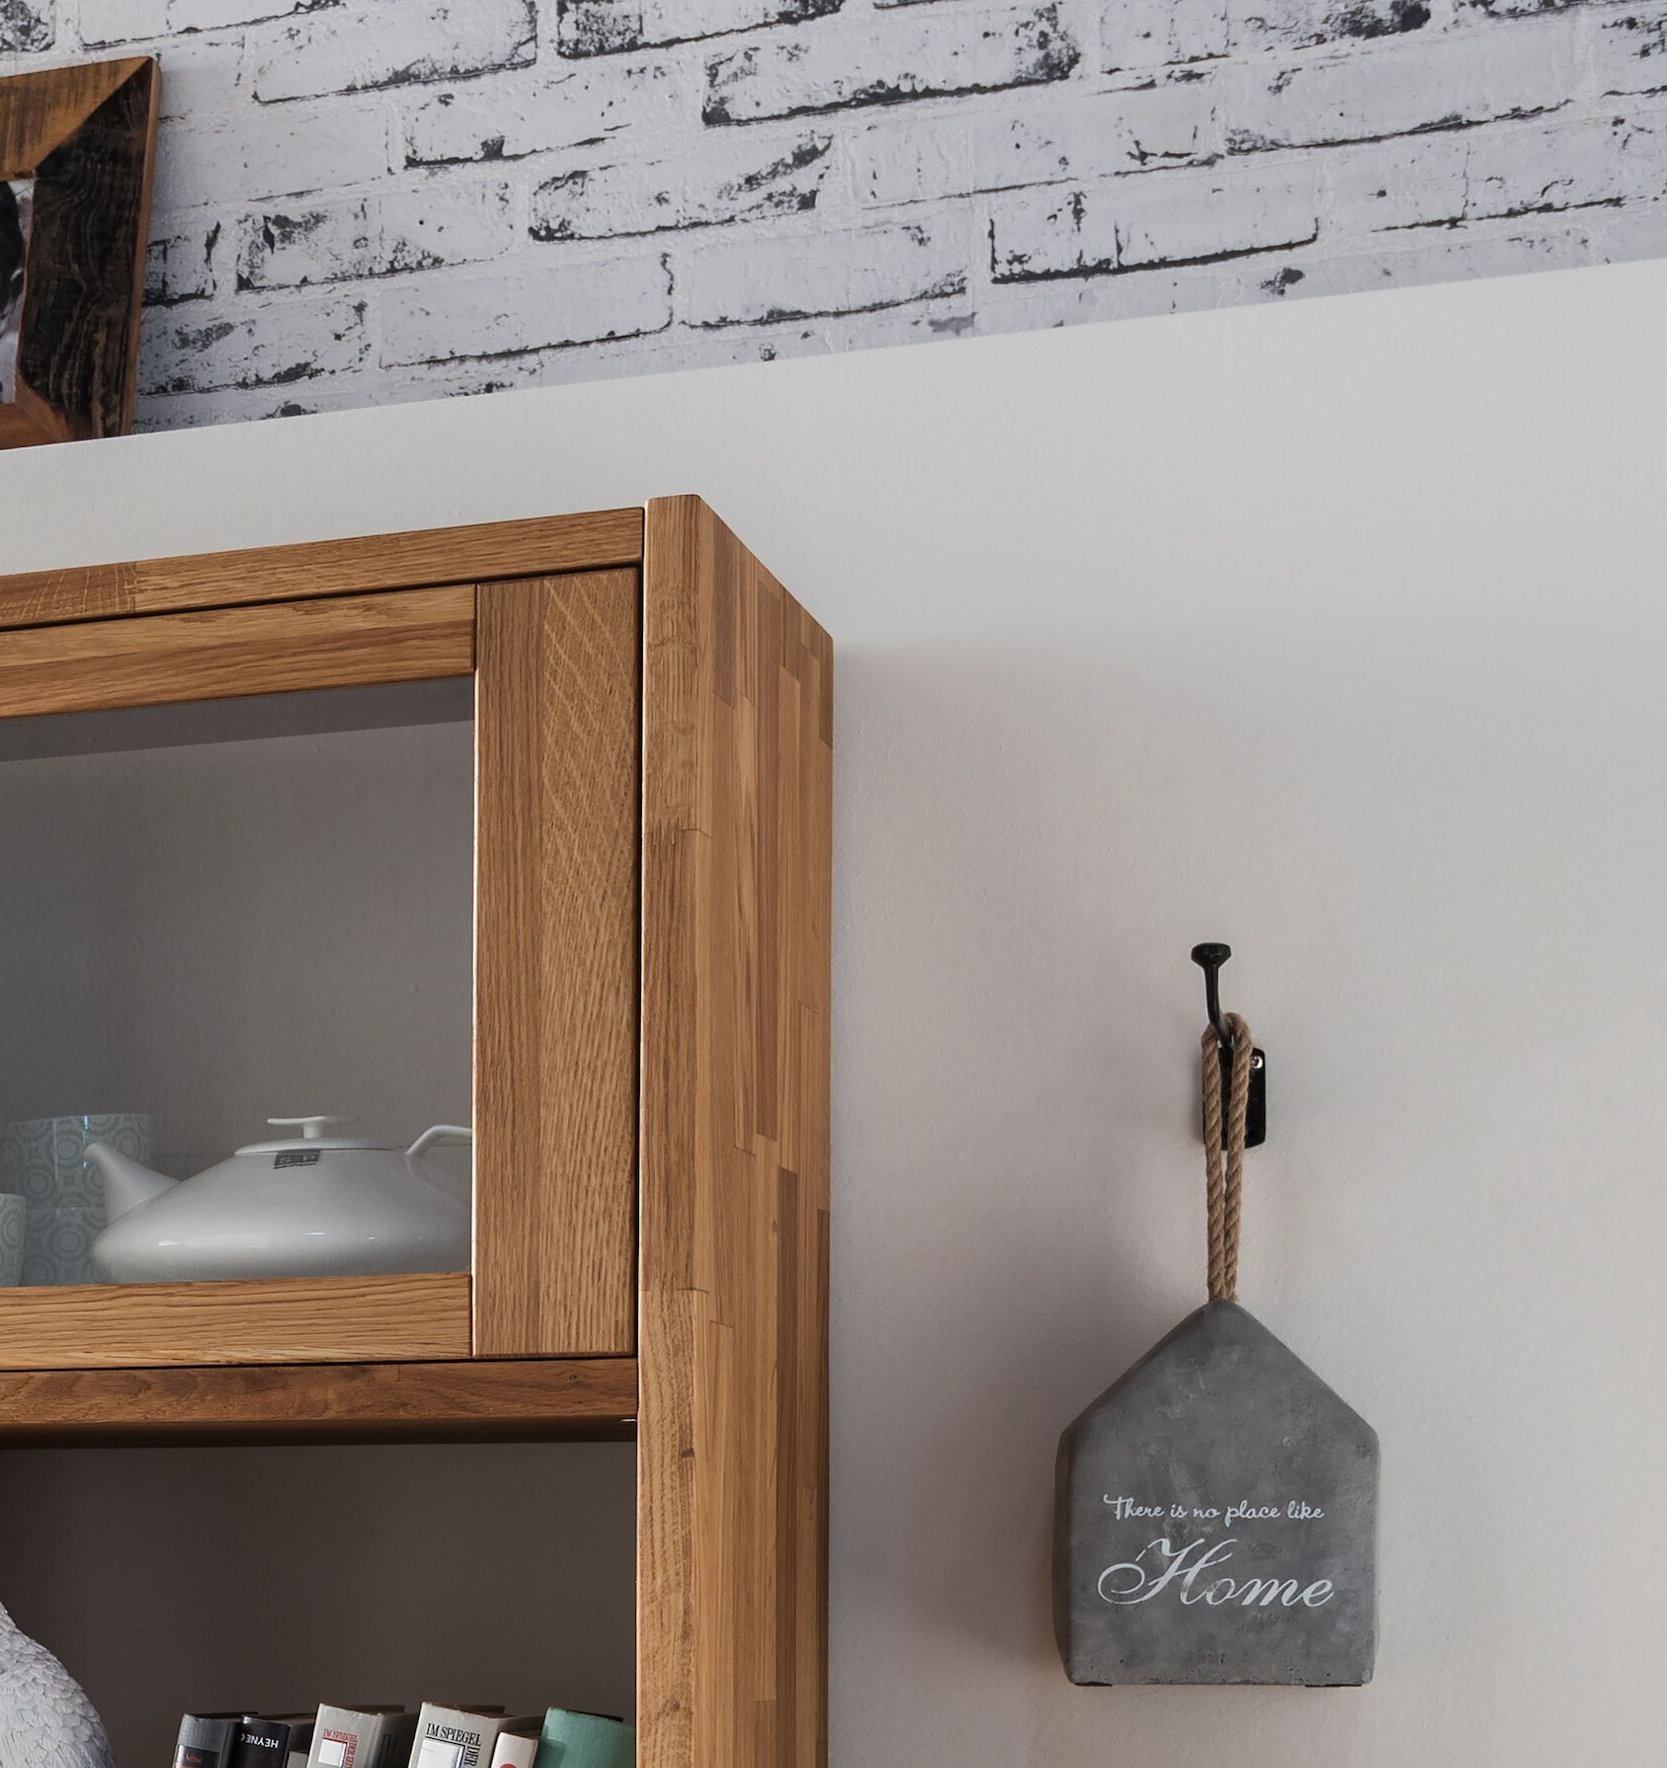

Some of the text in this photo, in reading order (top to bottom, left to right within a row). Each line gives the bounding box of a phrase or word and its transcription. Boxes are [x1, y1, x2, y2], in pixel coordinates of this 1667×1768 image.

[1103, 1495, 1324, 1527] There is no place like
[1097, 1537, 1334, 1608] Home
[426, 1723, 481, 1746] IM SPIEGEL
[463, 1745, 480, 1767] DER
